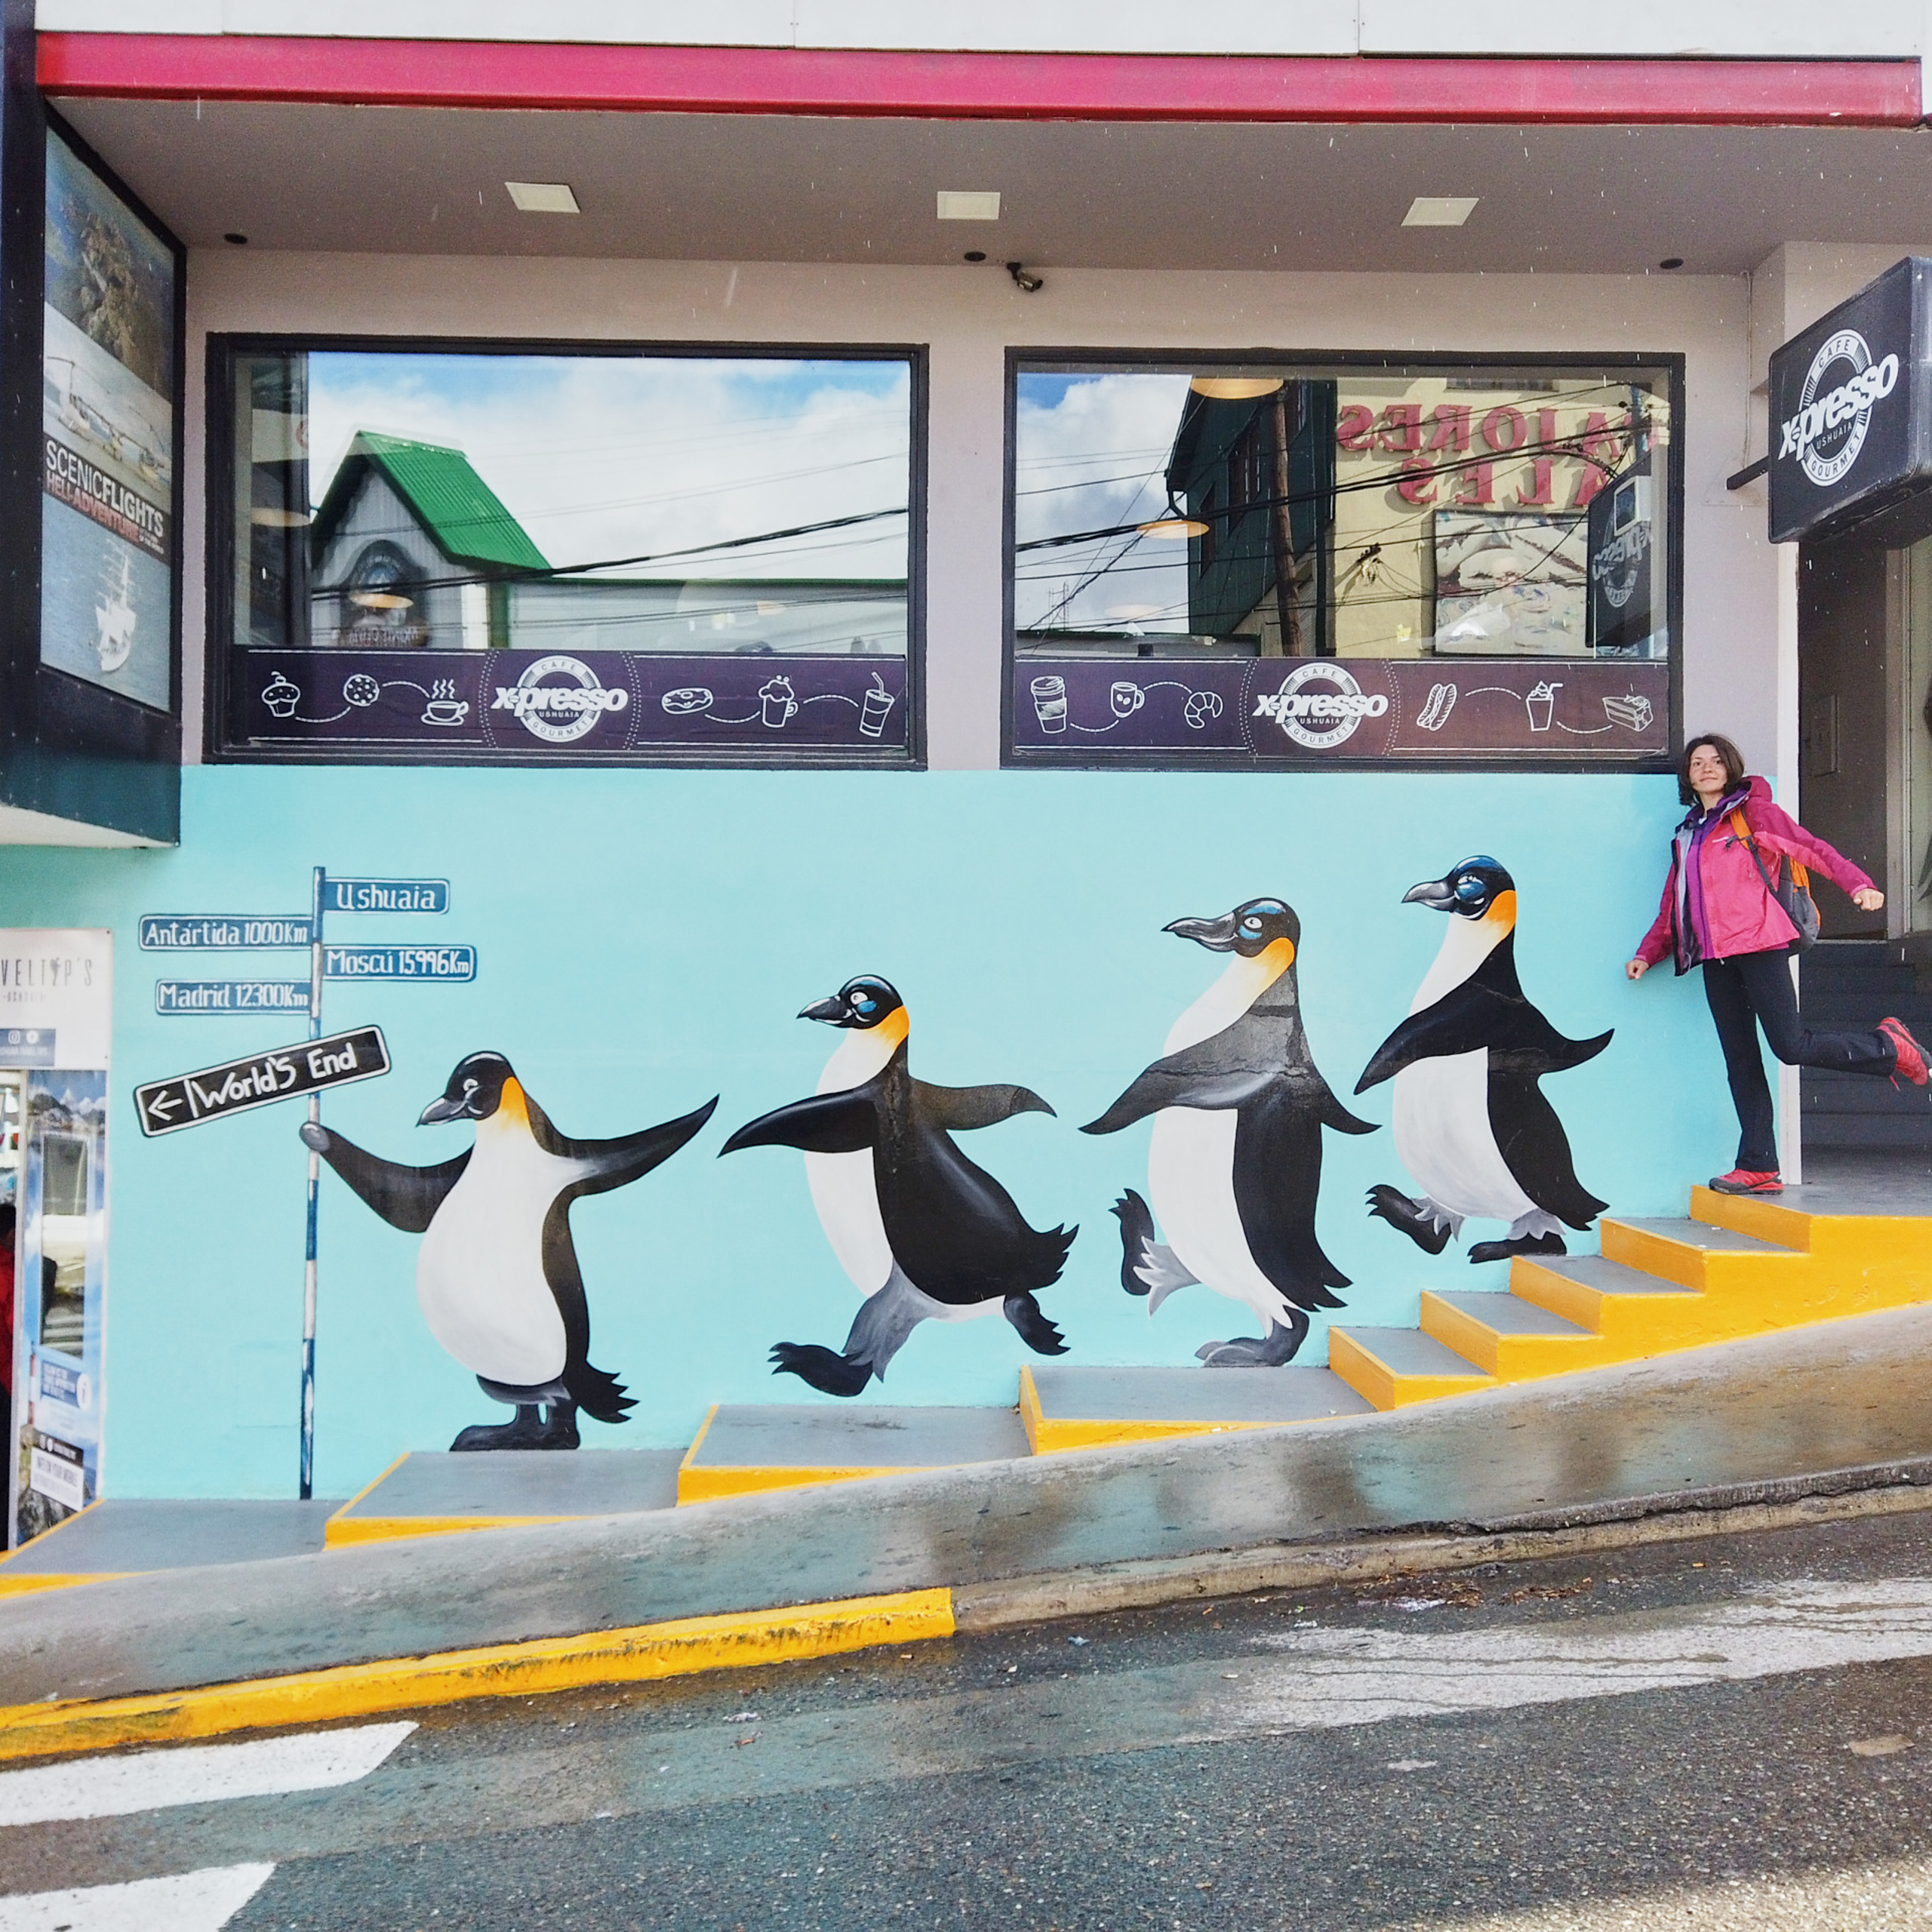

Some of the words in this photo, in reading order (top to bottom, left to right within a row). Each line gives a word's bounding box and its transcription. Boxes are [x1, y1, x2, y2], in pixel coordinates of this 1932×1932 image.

[1818, 339, 1850, 368] CAFE
[1816, 422, 1853, 450] USHUAIA
[1810, 434, 1860, 477] GOURMET
[541, 661, 576, 671] CAFE
[1303, 668, 1337, 678] CAFE
[533, 721, 588, 737] GOURMET
[1294, 728, 1349, 744] GOURMET
[337, 883, 436, 910] Ushuaia
[327, 949, 393, 974] Moscú
[159, 983, 230, 1008] Madrid
[307, 1041, 358, 1080] End
